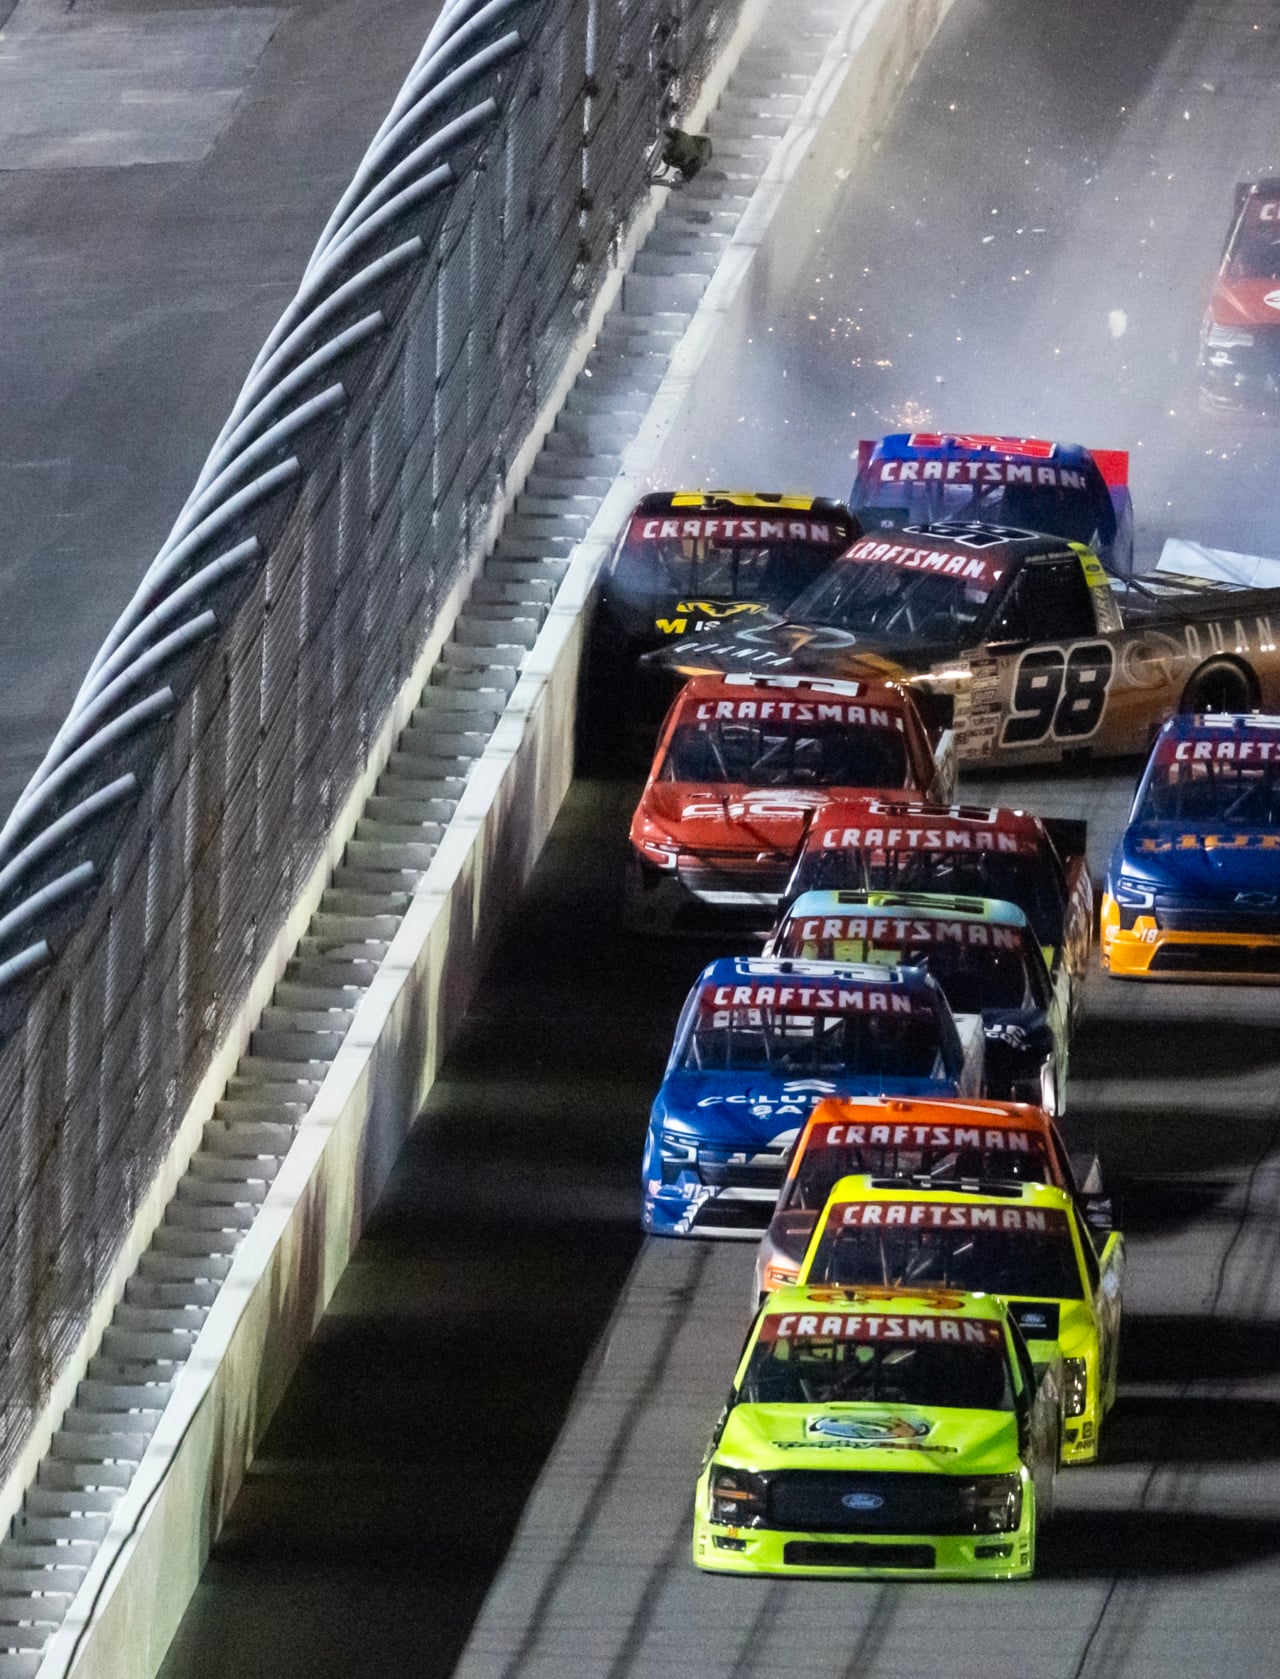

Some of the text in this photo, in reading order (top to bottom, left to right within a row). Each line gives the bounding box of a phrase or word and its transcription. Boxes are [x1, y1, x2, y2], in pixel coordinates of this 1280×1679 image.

[880, 461, 1083, 489] CRAFTSMAN
[642, 520, 830, 542] CRAFTSMAN
[846, 541, 986, 579] CRAFTSMAN
[999, 639, 1116, 747] 98
[696, 702, 888, 726] CRAFTSMAN
[823, 828, 1018, 851] CRAFTSMAN
[802, 919, 1012, 947] CRAFTSMAN
[714, 986, 912, 1013] CRAFTSMAN
[827, 1125, 1029, 1152] CRAFTSMAN
[843, 1205, 1046, 1230] CRAFTSMAN
[777, 1316, 987, 1343] CRAFTSMAN
